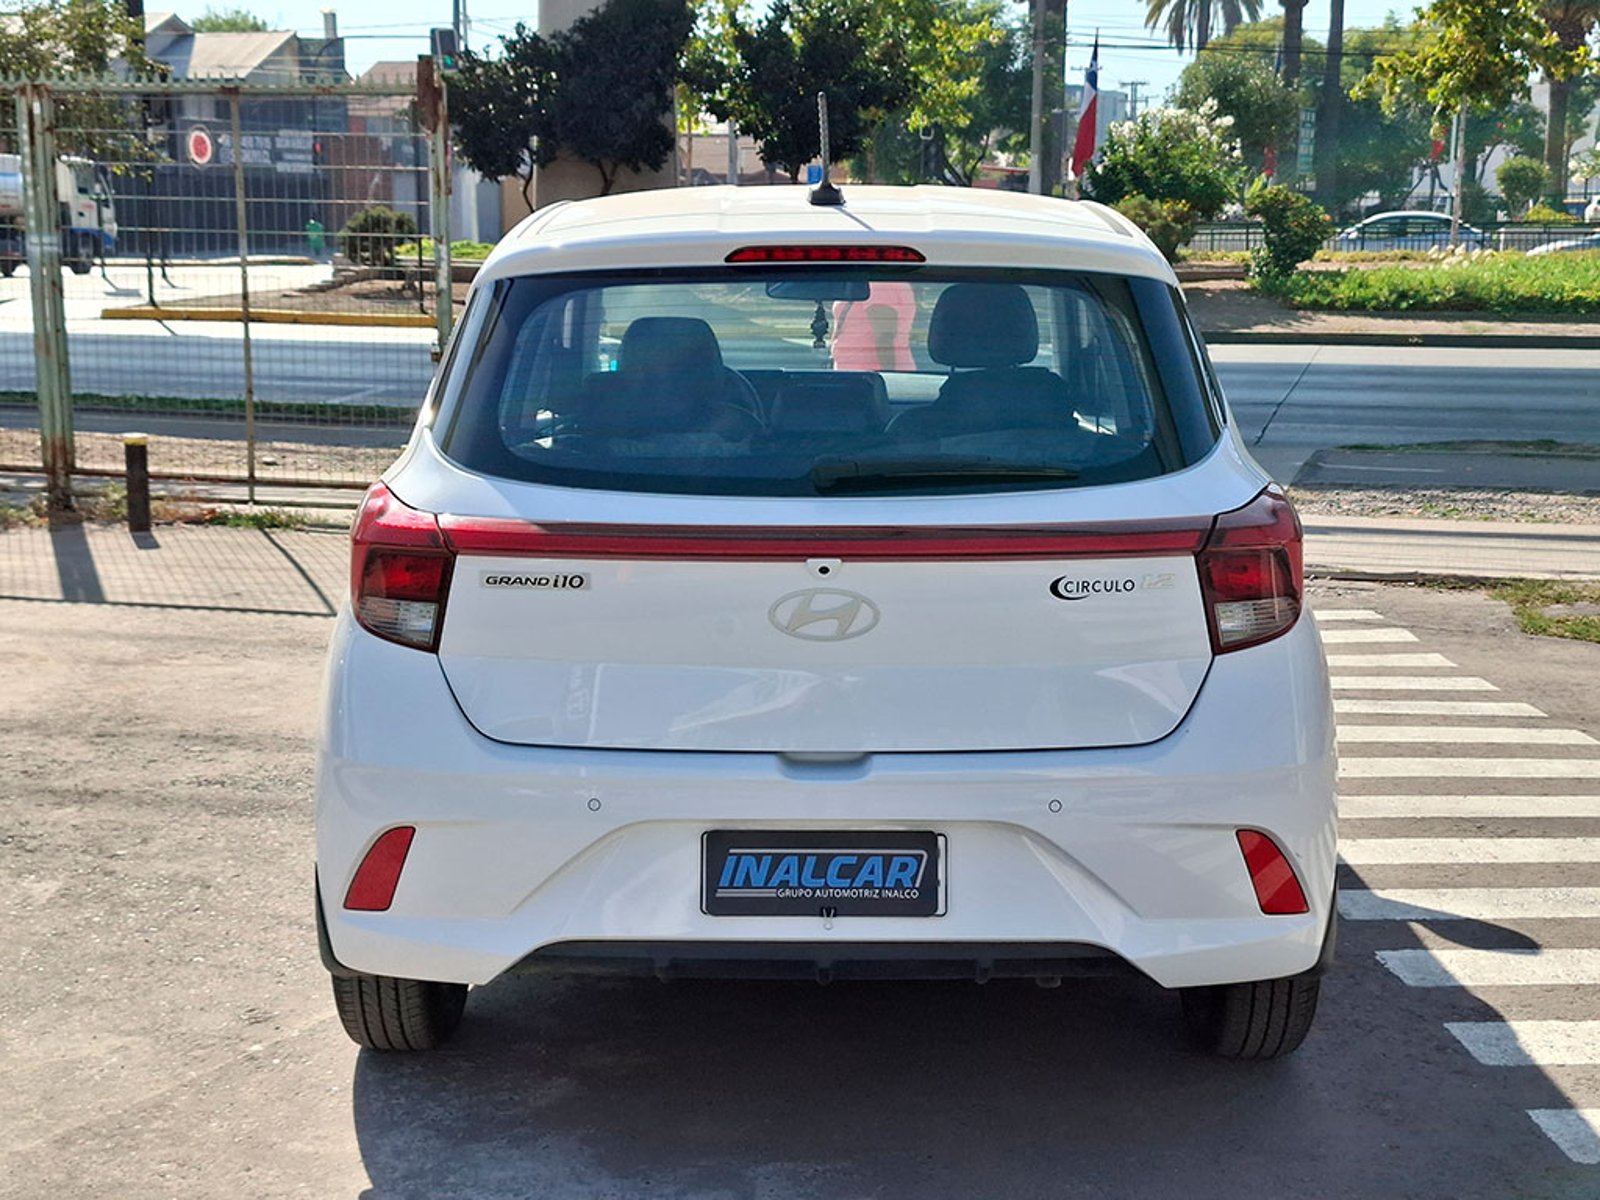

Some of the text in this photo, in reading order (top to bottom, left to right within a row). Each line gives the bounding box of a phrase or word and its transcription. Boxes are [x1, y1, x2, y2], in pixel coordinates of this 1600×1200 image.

[485, 574, 585, 589] GRAND i10
[1063, 577, 1136, 594] CIRCULO
[718, 855, 919, 888] INALCAR
[777, 888, 919, 899] GRUPO AUTOMOTRIZ INALCO
